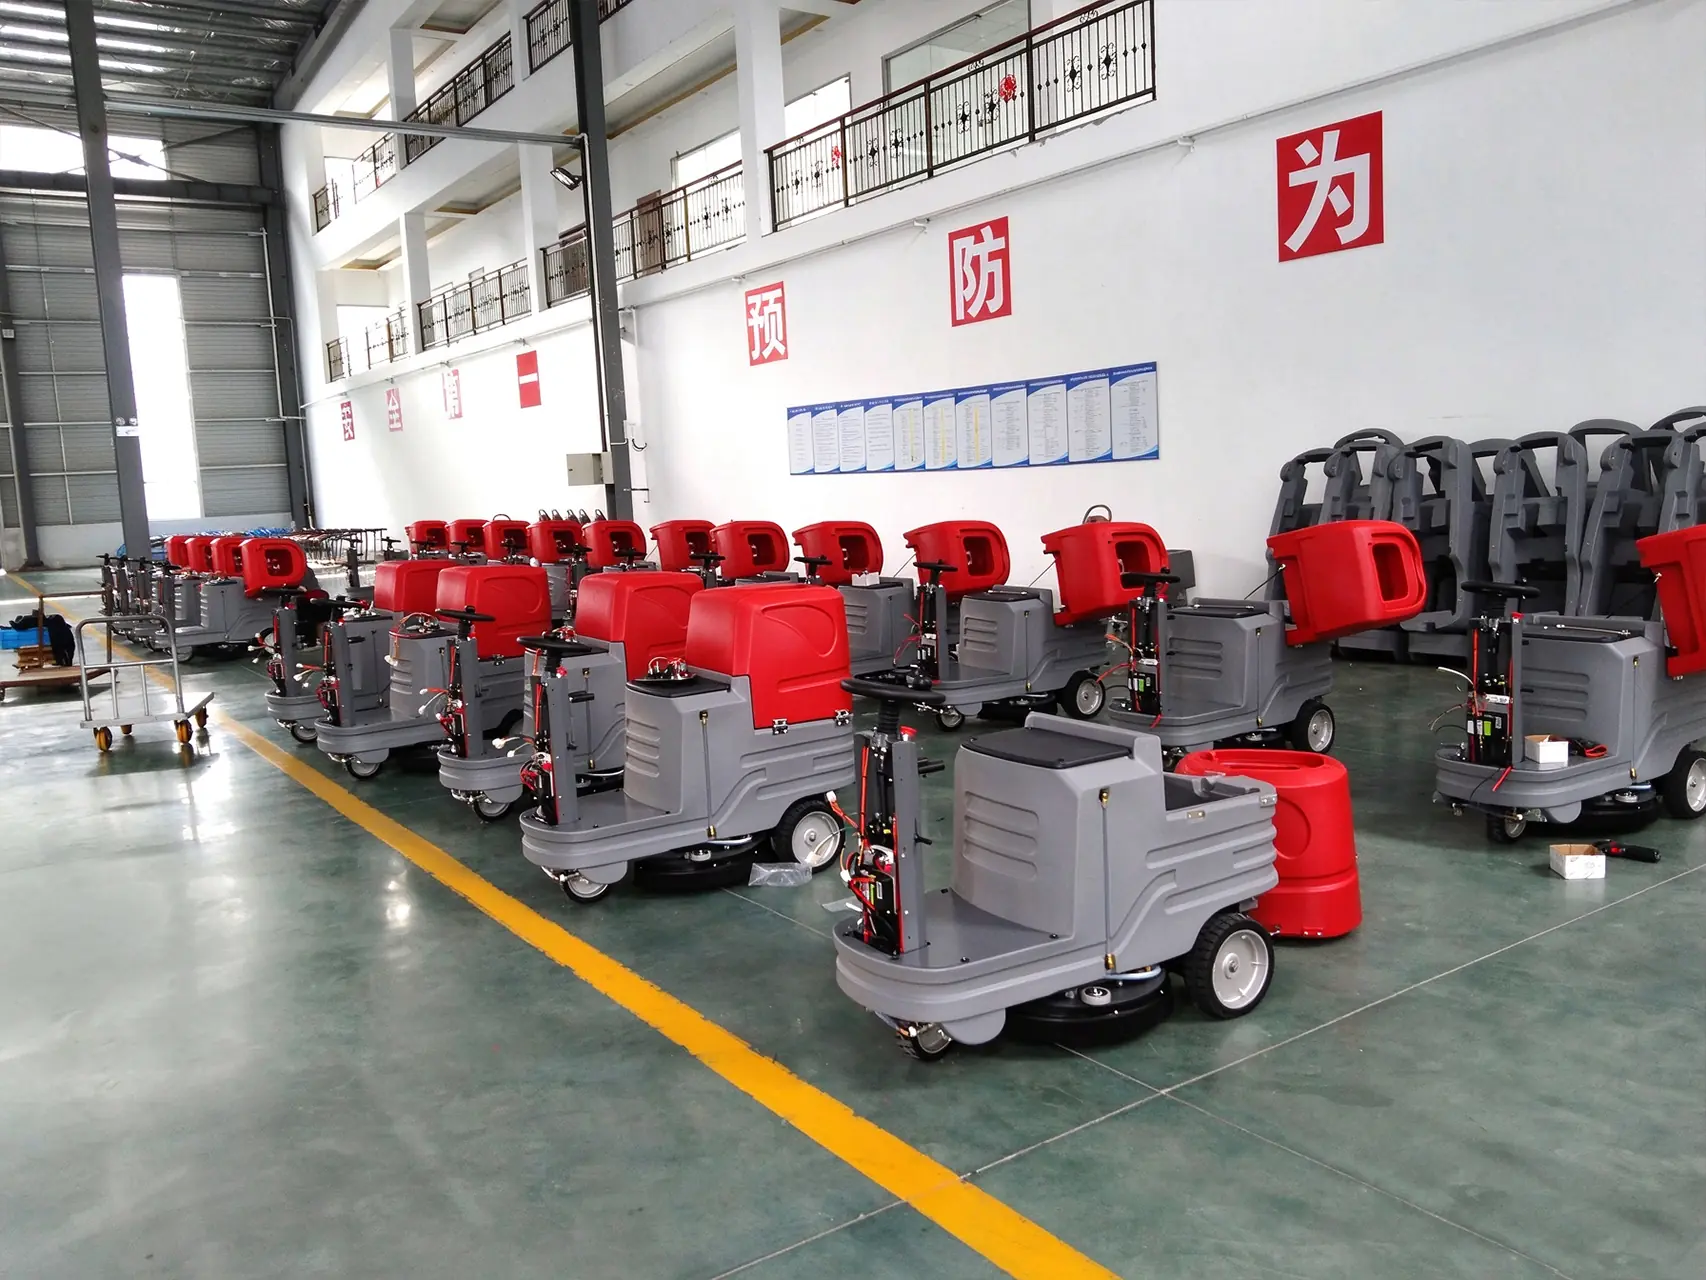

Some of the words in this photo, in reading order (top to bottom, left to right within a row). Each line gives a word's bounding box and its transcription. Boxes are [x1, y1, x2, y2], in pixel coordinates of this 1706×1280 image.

[747, 288, 786, 360] 预
[953, 225, 1005, 320] 防
[1284, 129, 1370, 253] 为
[388, 391, 402, 429] 全
